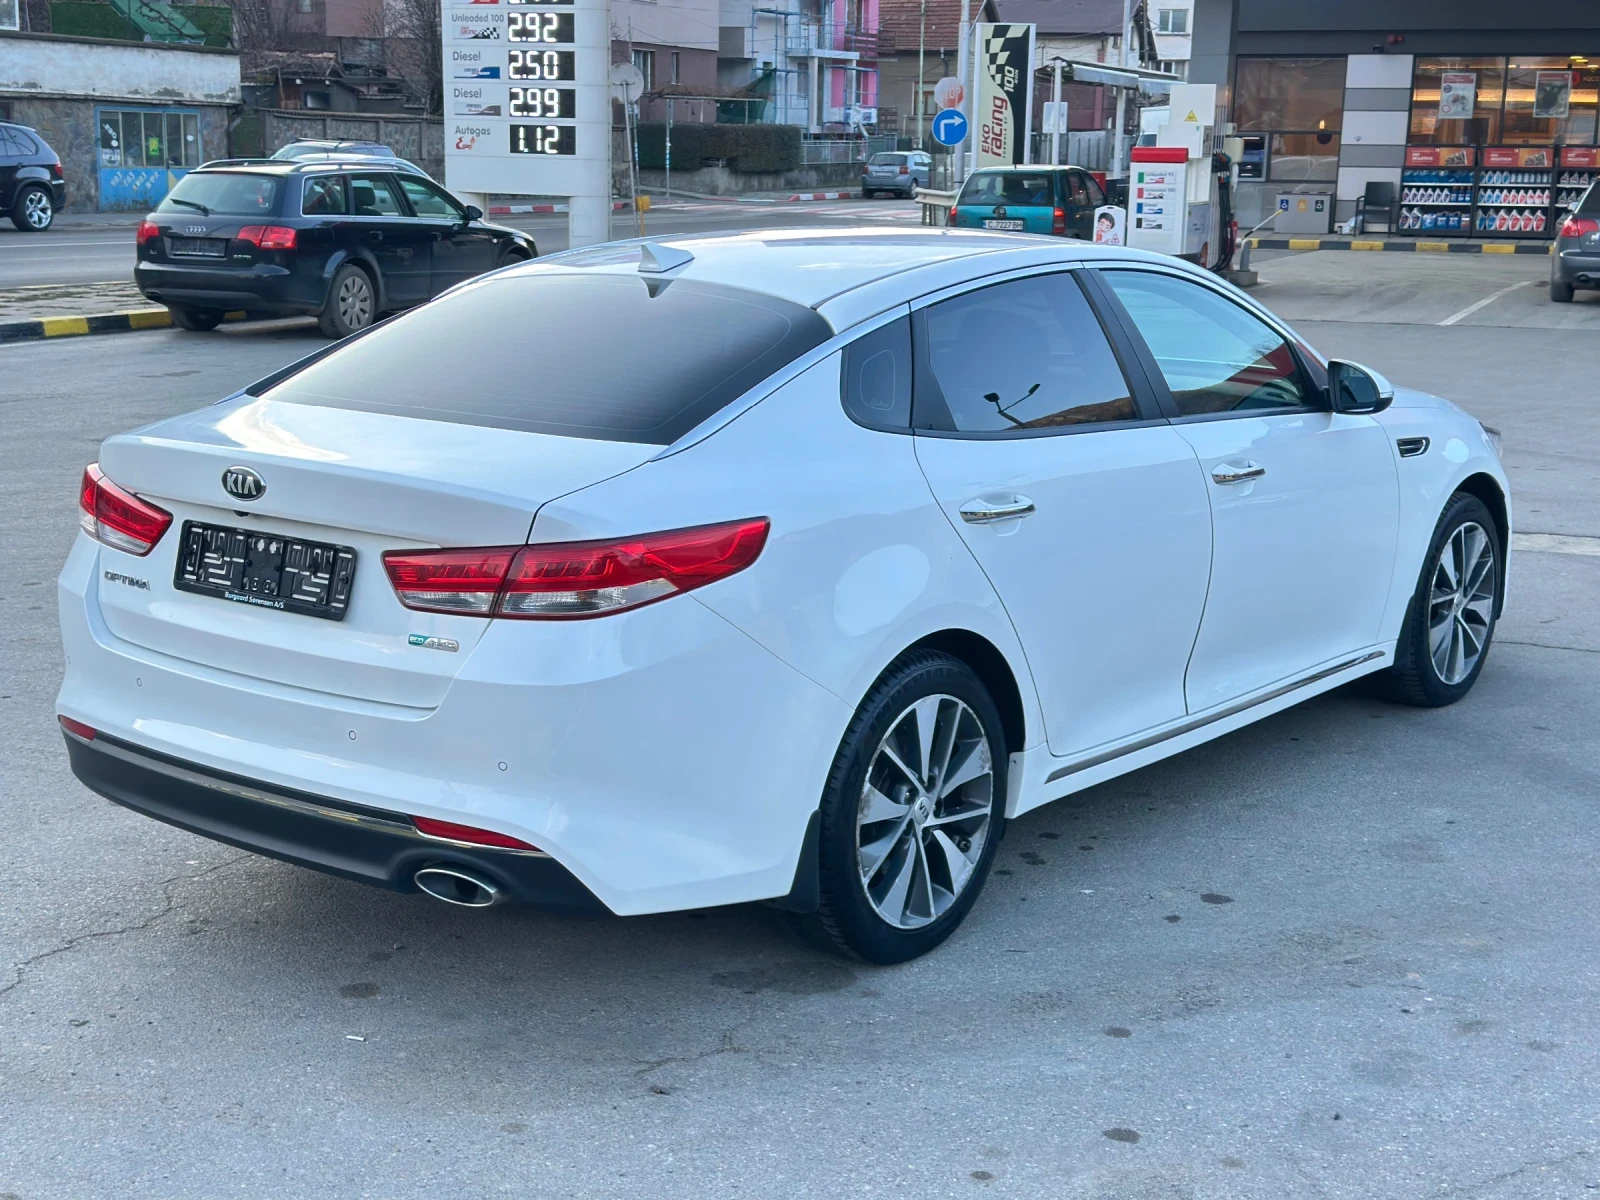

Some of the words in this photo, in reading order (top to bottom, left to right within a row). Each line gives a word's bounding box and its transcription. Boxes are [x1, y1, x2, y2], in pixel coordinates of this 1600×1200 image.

[451, 13, 489, 23] Unleaded
[491, 14, 505, 23] 100
[508, 12, 558, 42] 2.92
[453, 51, 481, 61] Diesel
[509, 50, 558, 79] 2.50
[1004, 65, 1015, 92] 100
[453, 88, 482, 98] Diesel
[509, 88, 559, 117] 2.99
[455, 126, 491, 137] Autogas
[982, 123, 991, 154] EKO
[990, 95, 1008, 157] racing
[519, 125, 559, 154] 1.12
[226, 472, 257, 495] KIA
[104, 570, 151, 591] OPTIMA
[274, 600, 285, 609] A/S
